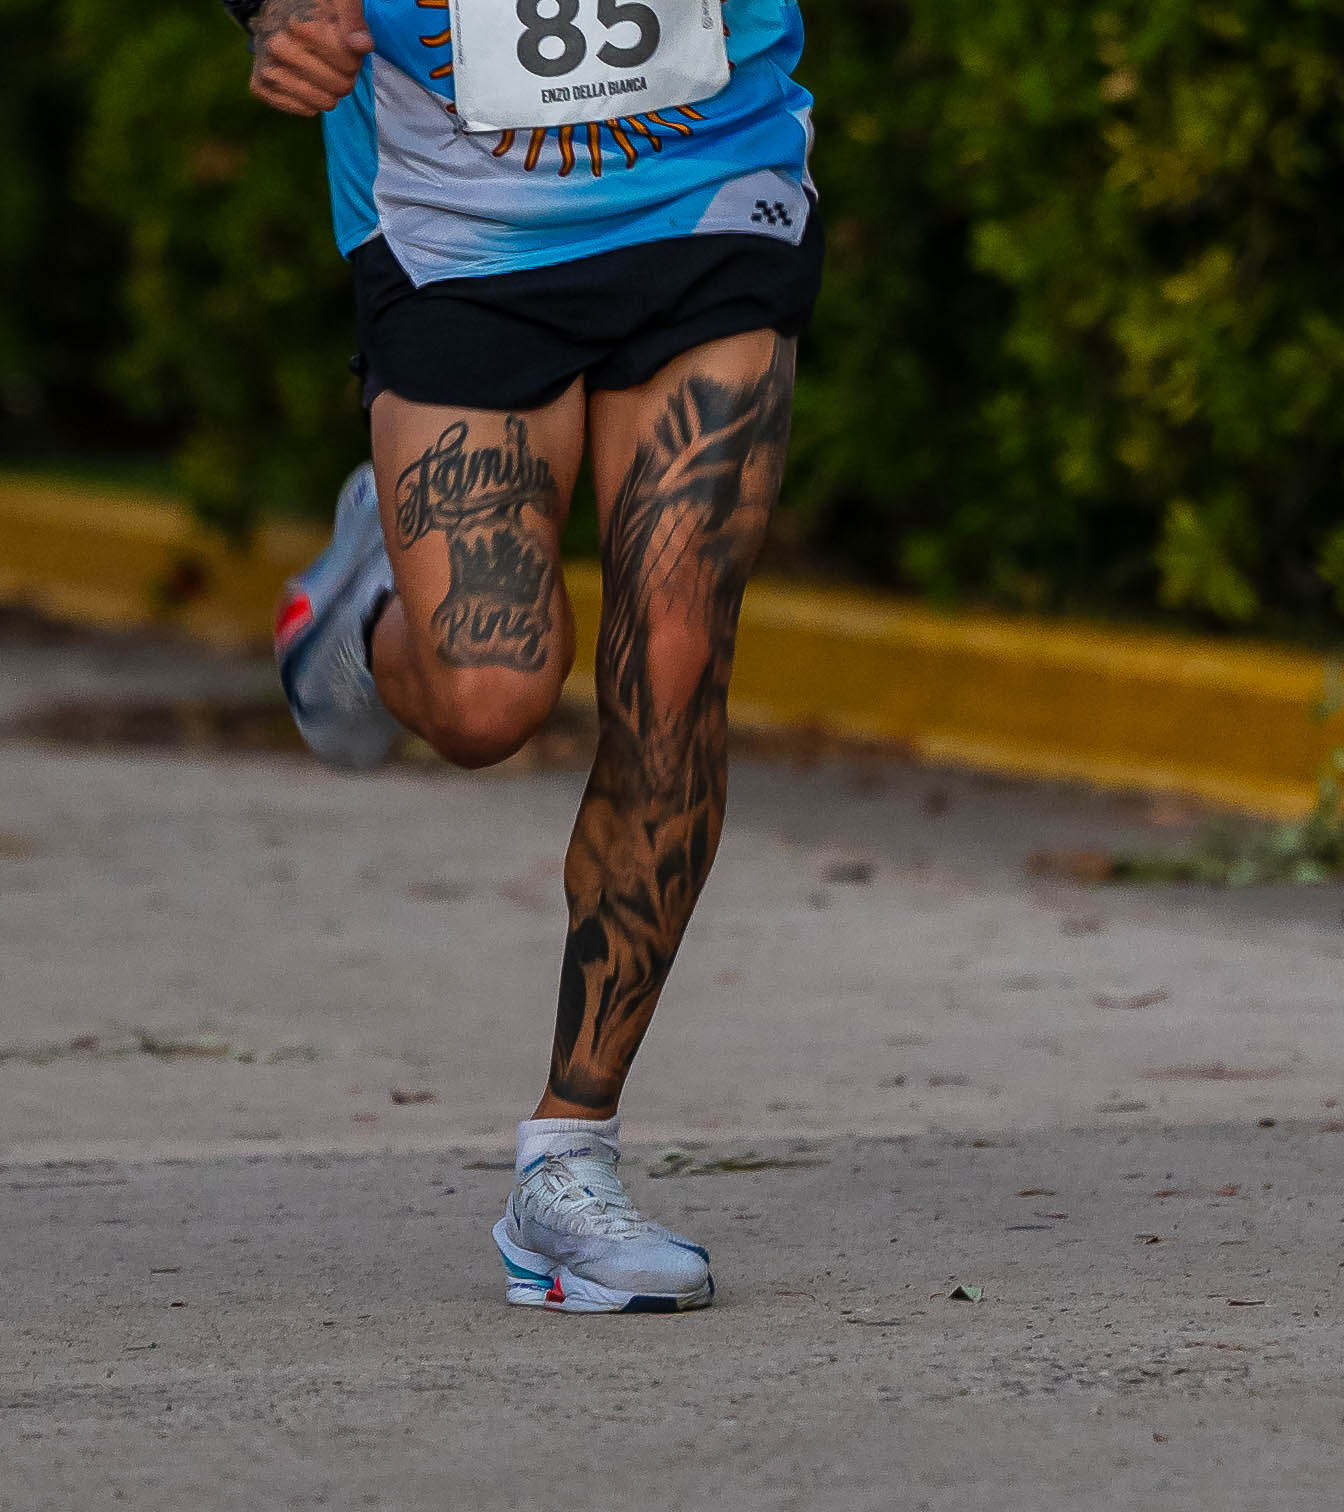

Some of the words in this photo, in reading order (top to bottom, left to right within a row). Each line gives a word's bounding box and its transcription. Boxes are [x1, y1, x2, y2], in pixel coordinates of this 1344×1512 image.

[541, 87, 571, 104] ENZO
[572, 81, 607, 101] DELLA
[607, 76, 648, 96] BIANCA
